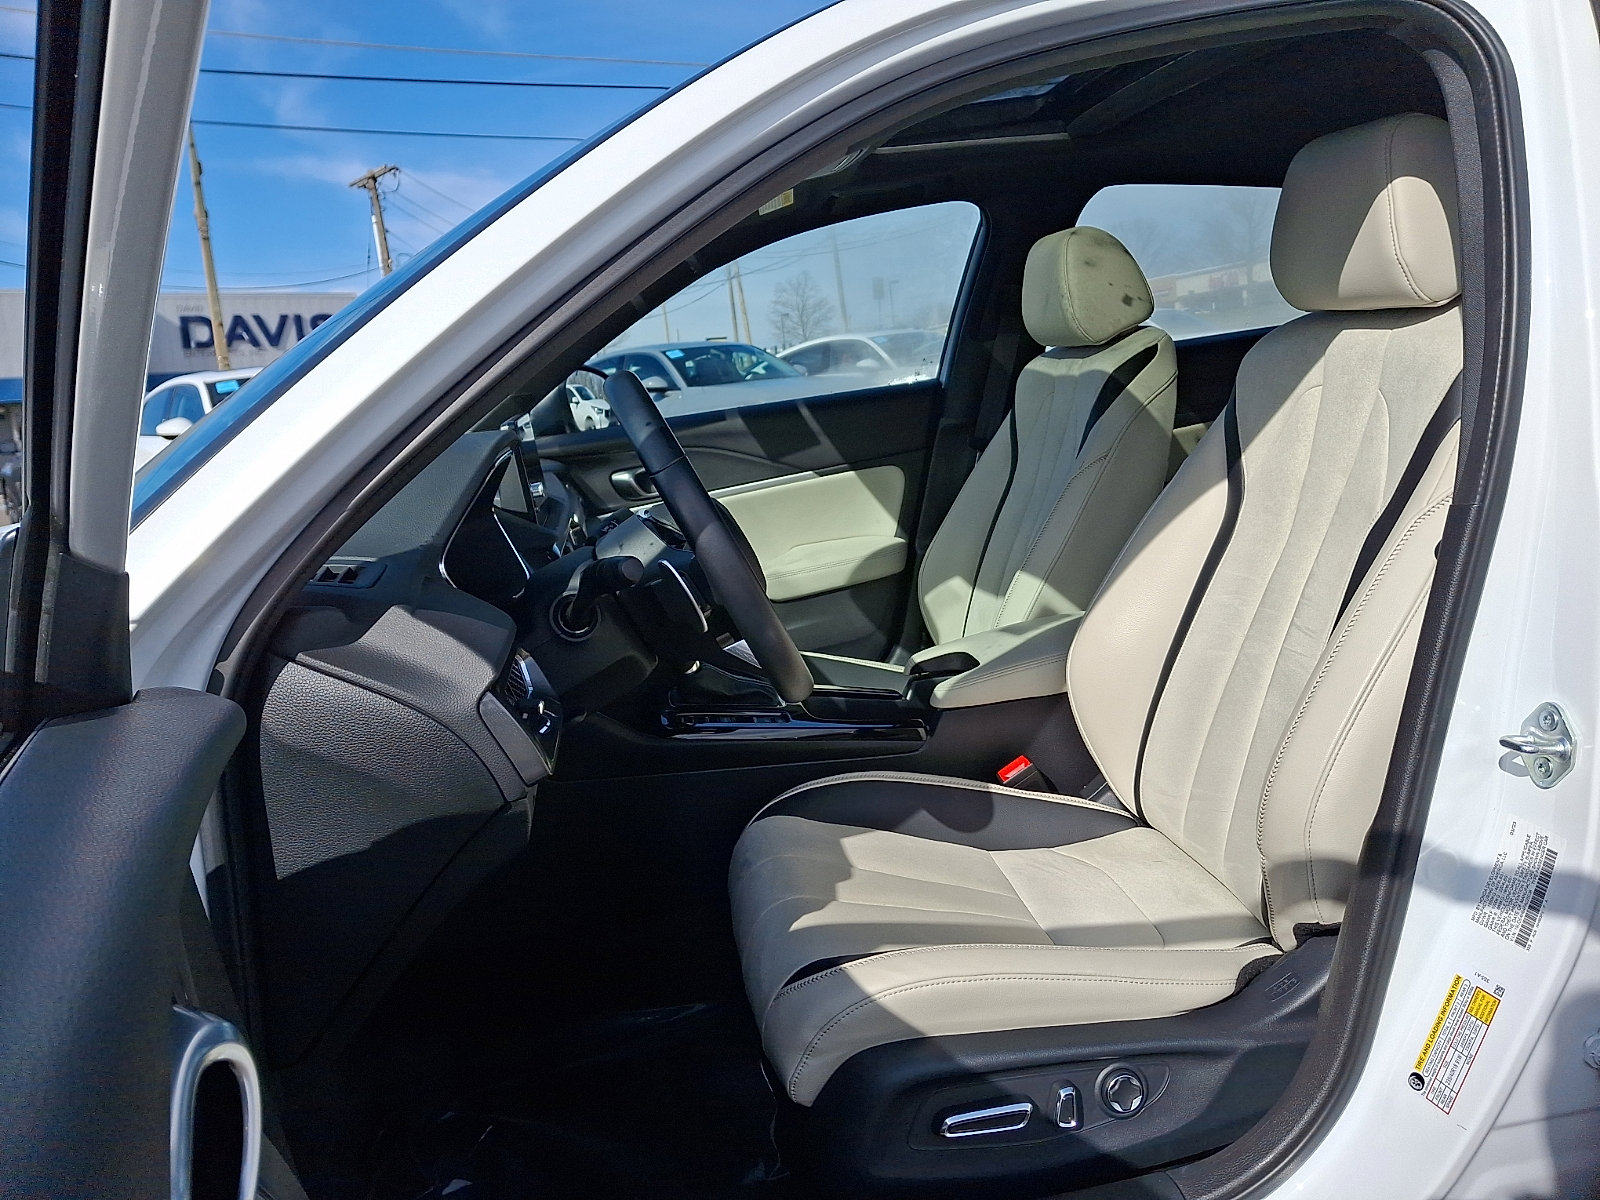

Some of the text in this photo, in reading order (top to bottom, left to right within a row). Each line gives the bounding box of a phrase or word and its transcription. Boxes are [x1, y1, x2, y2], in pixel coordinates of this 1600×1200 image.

[1415, 974, 1461, 1070] TIRE AND LOADING INFORMATION
